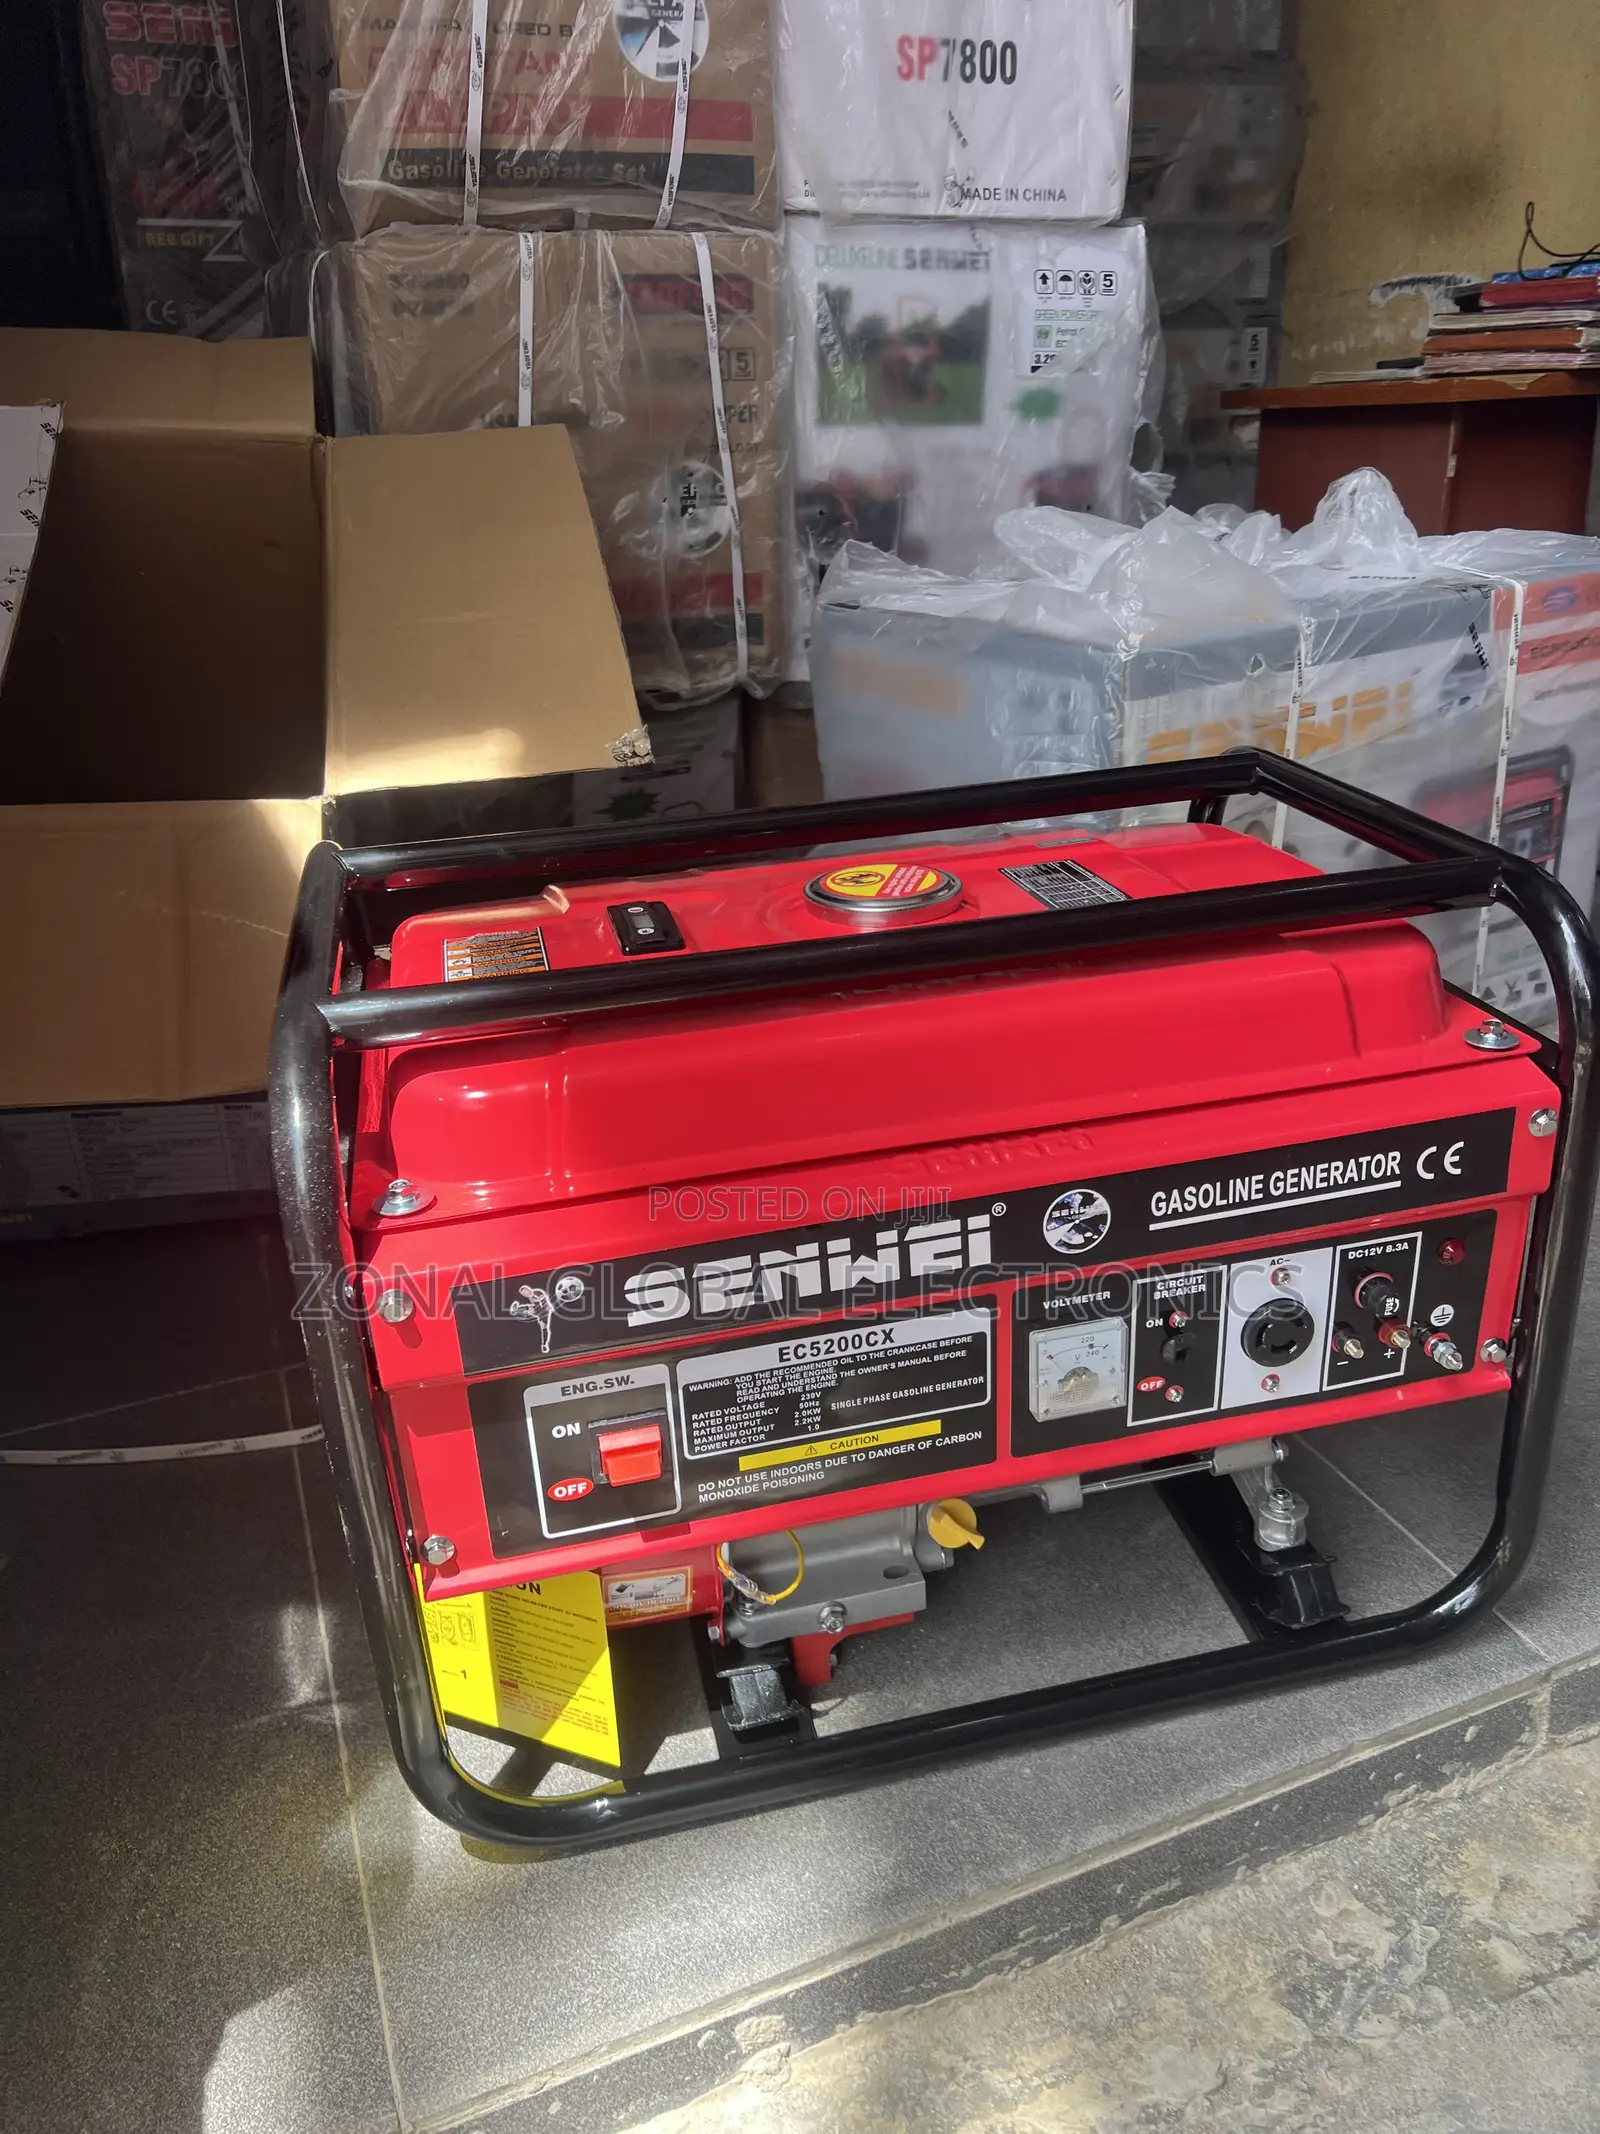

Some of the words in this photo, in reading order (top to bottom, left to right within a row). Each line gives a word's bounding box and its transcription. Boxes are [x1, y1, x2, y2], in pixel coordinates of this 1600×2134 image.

[897, 35, 1018, 84] SP7800
[960, 187, 1001, 201] MADE
[1005, 187, 1018, 201] IN
[1022, 188, 1067, 202] CHINA
[1102, 273, 1114, 288] 5
[738, 350, 756, 373] 5
[1416, 1141, 1465, 1181] CE
[1151, 1174, 1264, 1218] GASOLINE
[1269, 1151, 1401, 1197] GENERATOR
[1348, 1247, 1384, 1260] DC12V
[1386, 1242, 1409, 1253] 8.3A
[1153, 1284, 1206, 1300] BREAKER
[1156, 1275, 1204, 1290] CIRCUIT
[1043, 1291, 1111, 1310] VOLTMETER
[1384, 1296, 1395, 1316] FUSE
[1145, 1318, 1164, 1328] ON
[778, 1327, 895, 1363] EC5200CX
[1080, 1336, 1095, 1344] 220
[689, 1378, 733, 1392] WARNING:
[734, 1374, 752, 1384] ADD
[754, 1371, 771, 1381] THE
[773, 1359, 838, 1377] RECOMMENDED
[840, 1357, 854, 1365] OIL
[856, 1354, 867, 1362] TO
[869, 1350, 885, 1359] THE
[887, 1342, 938, 1357] CRANKCASE
[939, 1335, 973, 1348] BEFORE
[1085, 1349, 1100, 1357] 240
[736, 1387, 760, 1397] READ
[762, 1383, 780, 1393] AND
[781, 1373, 838, 1389] UNDERSTAND
[840, 1370, 856, 1378] THE
[857, 1363, 896, 1375] OWNER'S
[897, 1357, 933, 1368] MANUAL
[934, 1350, 967, 1361] BEFORE
[736, 1381, 754, 1390] YOU
[756, 1376, 783, 1387] START
[785, 1373, 801, 1382] THE
[803, 1367, 837, 1379] ENGINE.
[560, 1374, 635, 1397] ENG.SW.
[736, 1389, 785, 1403] OPERATING
[787, 1384, 804, 1394] THE
[805, 1380, 839, 1391] ENGINE.
[831, 1398, 861, 1411] SINGLE
[863, 1392, 891, 1404] PHASE
[892, 1385, 934, 1399] GASOLINE
[935, 1375, 985, 1391] GENERATOR
[1140, 1380, 1163, 1391] OFF
[691, 1409, 722, 1421] RATED
[723, 1402, 766, 1415] VOLTAGE
[801, 1392, 822, 1401] 230V
[692, 1418, 723, 1429] RATED
[724, 1407, 780, 1423] FREQUENCY
[693, 1425, 724, 1437] RATED
[725, 1418, 762, 1431] OUTPUT
[794, 1408, 822, 1418] 2.0KW
[551, 1422, 581, 1438] ON
[694, 1431, 738, 1445] MAXIMUM
[739, 1424, 776, 1436] OUTPUT
[794, 1415, 822, 1426] 2.2KW
[694, 1442, 728, 1453] POWER
[729, 1433, 766, 1446] FACTOR
[830, 1434, 879, 1450] CAUTION
[698, 1482, 715, 1493] DO
[717, 1476, 742, 1490] NOT
[744, 1471, 767, 1484] USE
[770, 1460, 822, 1479] INDOORS
[825, 1455, 848, 1469] DUE
[850, 1452, 866, 1463] TO
[868, 1443, 916, 1461] DANGER
[917, 1439, 933, 1451] OF
[935, 1430, 983, 1448] CARBON
[553, 1482, 588, 1497] OFF
[699, 1483, 760, 1503] MONOXIDE
[762, 1471, 825, 1491] POISONING
